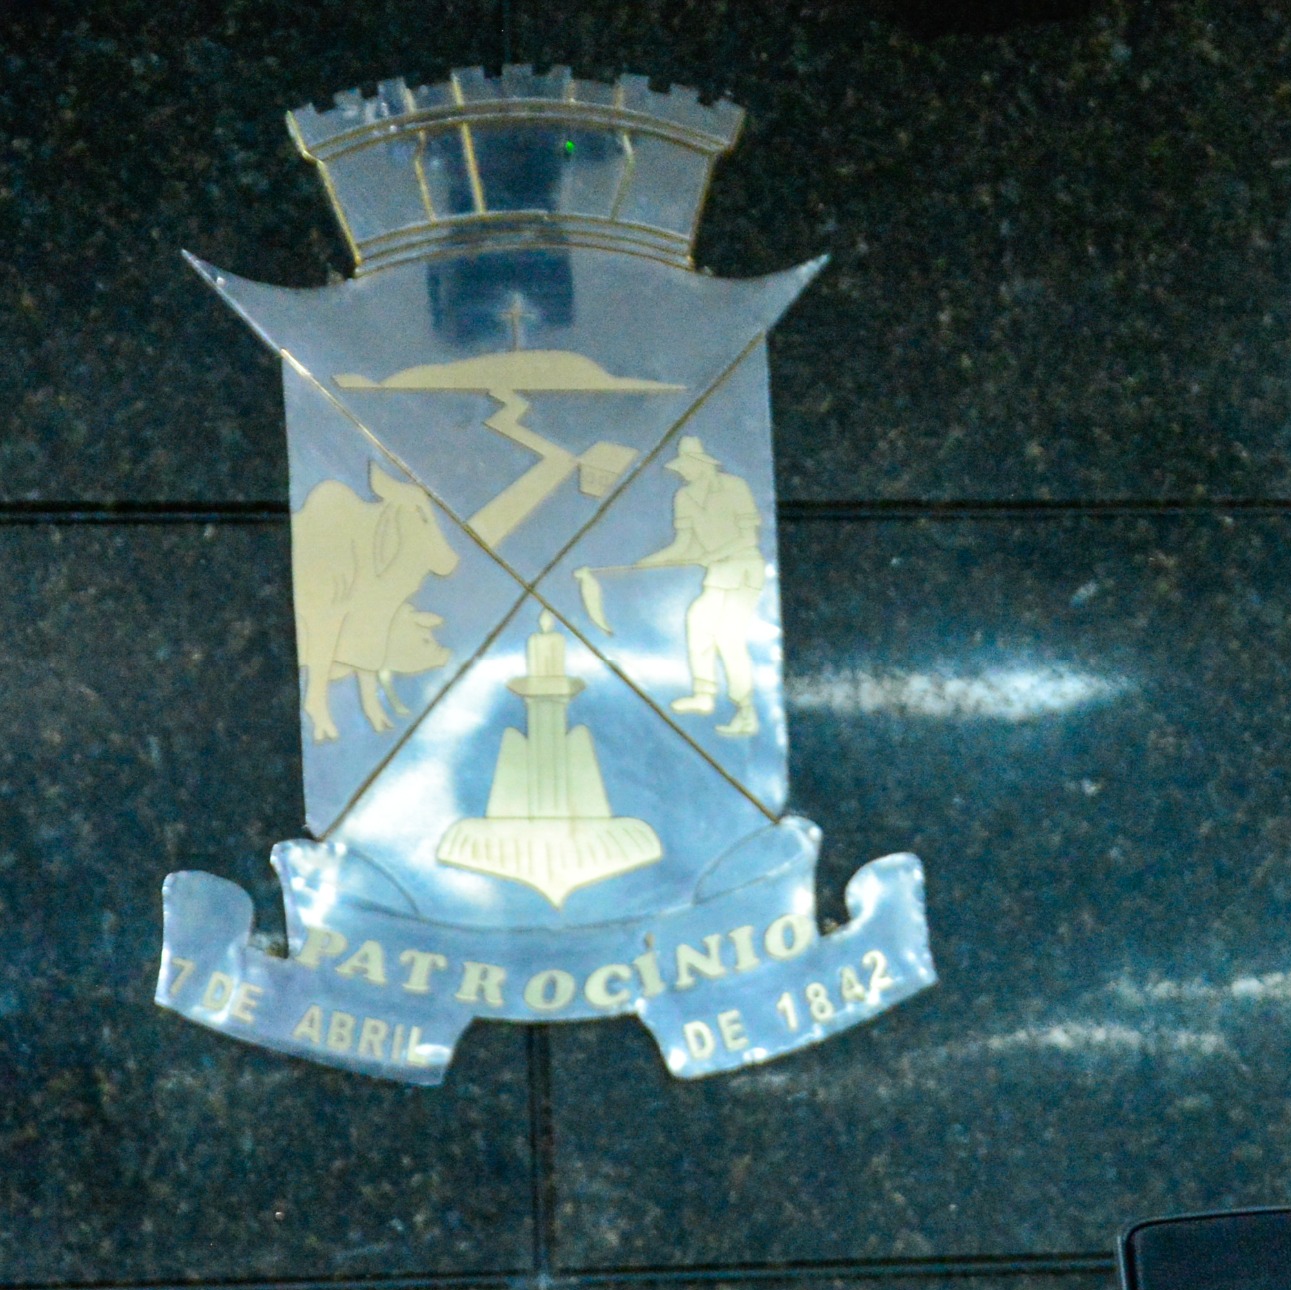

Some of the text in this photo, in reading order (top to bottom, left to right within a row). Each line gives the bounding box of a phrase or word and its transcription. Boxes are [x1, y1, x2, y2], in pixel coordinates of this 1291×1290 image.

[168, 957, 430, 1067] 7 DE ABRIL
[295, 913, 813, 1012] PATROCÍNIO
[683, 949, 894, 1060] DE 1842
